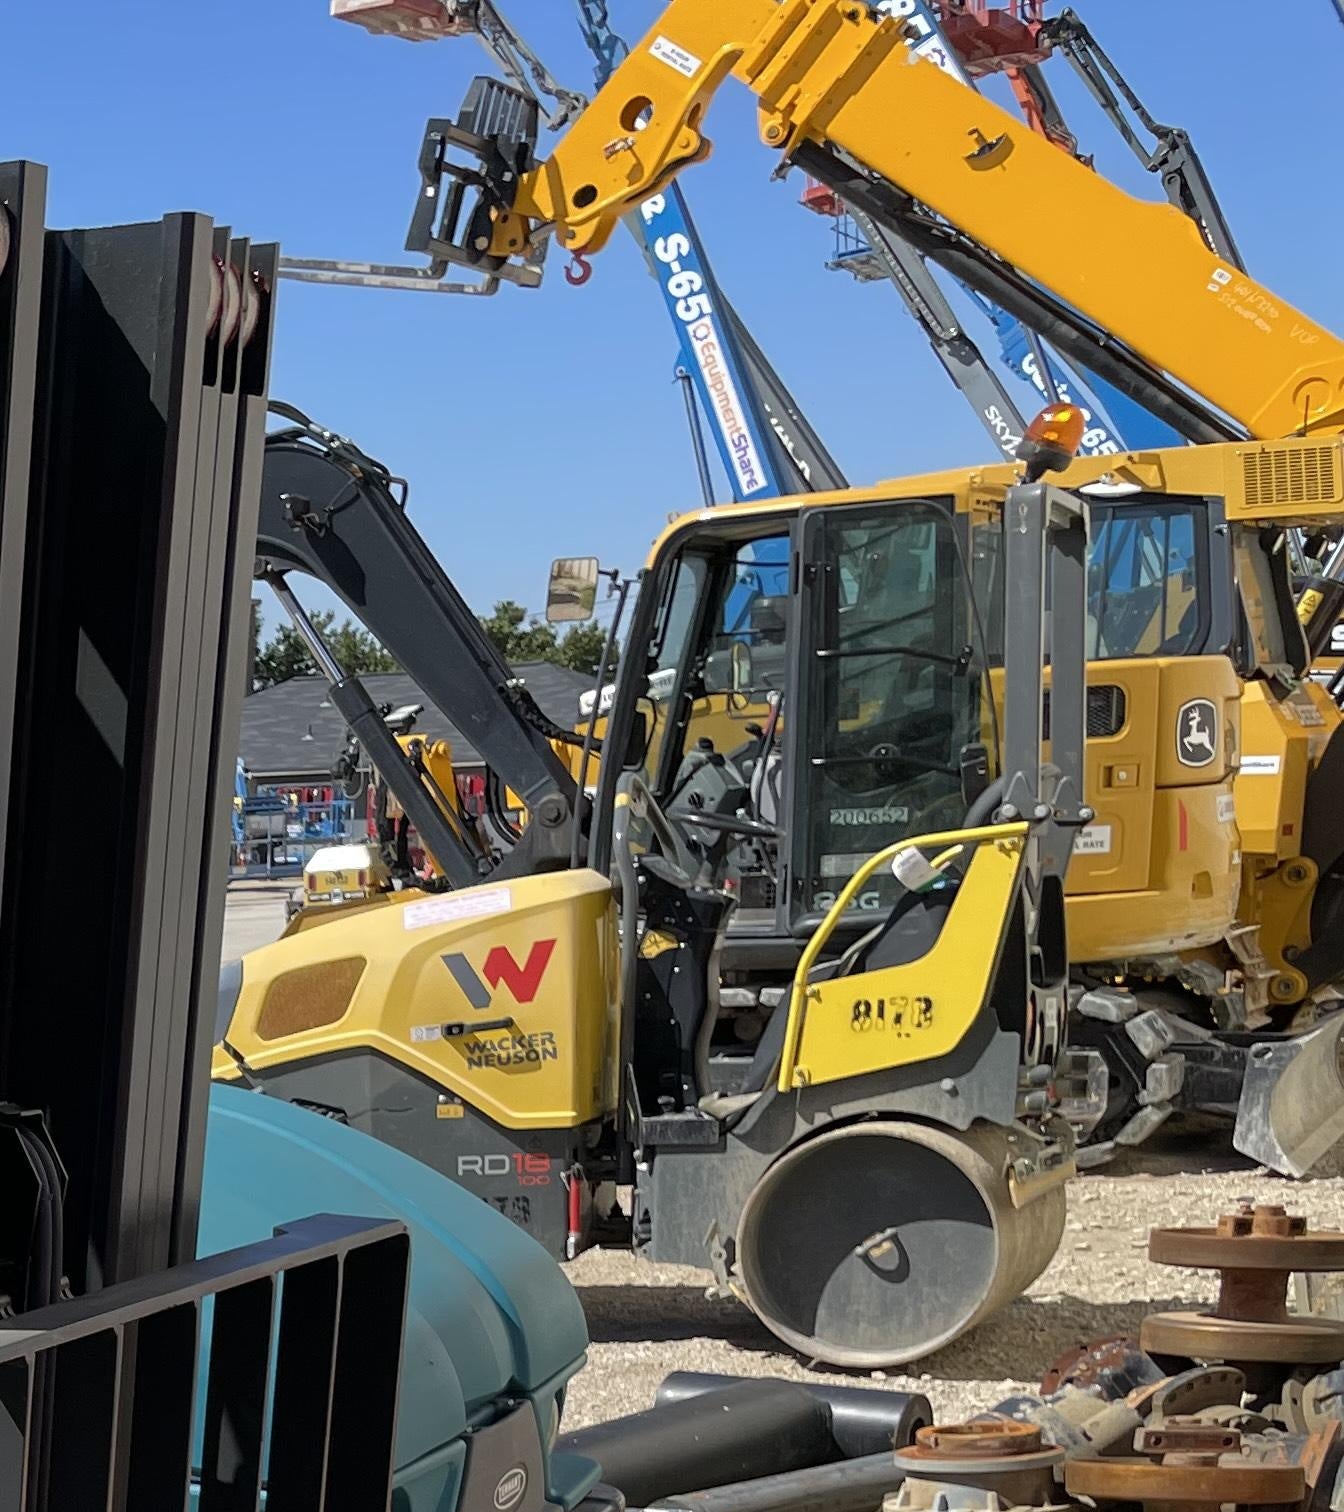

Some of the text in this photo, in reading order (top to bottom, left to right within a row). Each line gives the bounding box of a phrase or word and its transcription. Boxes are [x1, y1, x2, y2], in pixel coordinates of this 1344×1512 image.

[655, 232, 713, 323] S-65
[700, 340, 759, 491] EquipmentShare
[464, 1031, 556, 1054] WACKER
[466, 1047, 558, 1071] NEUSON
